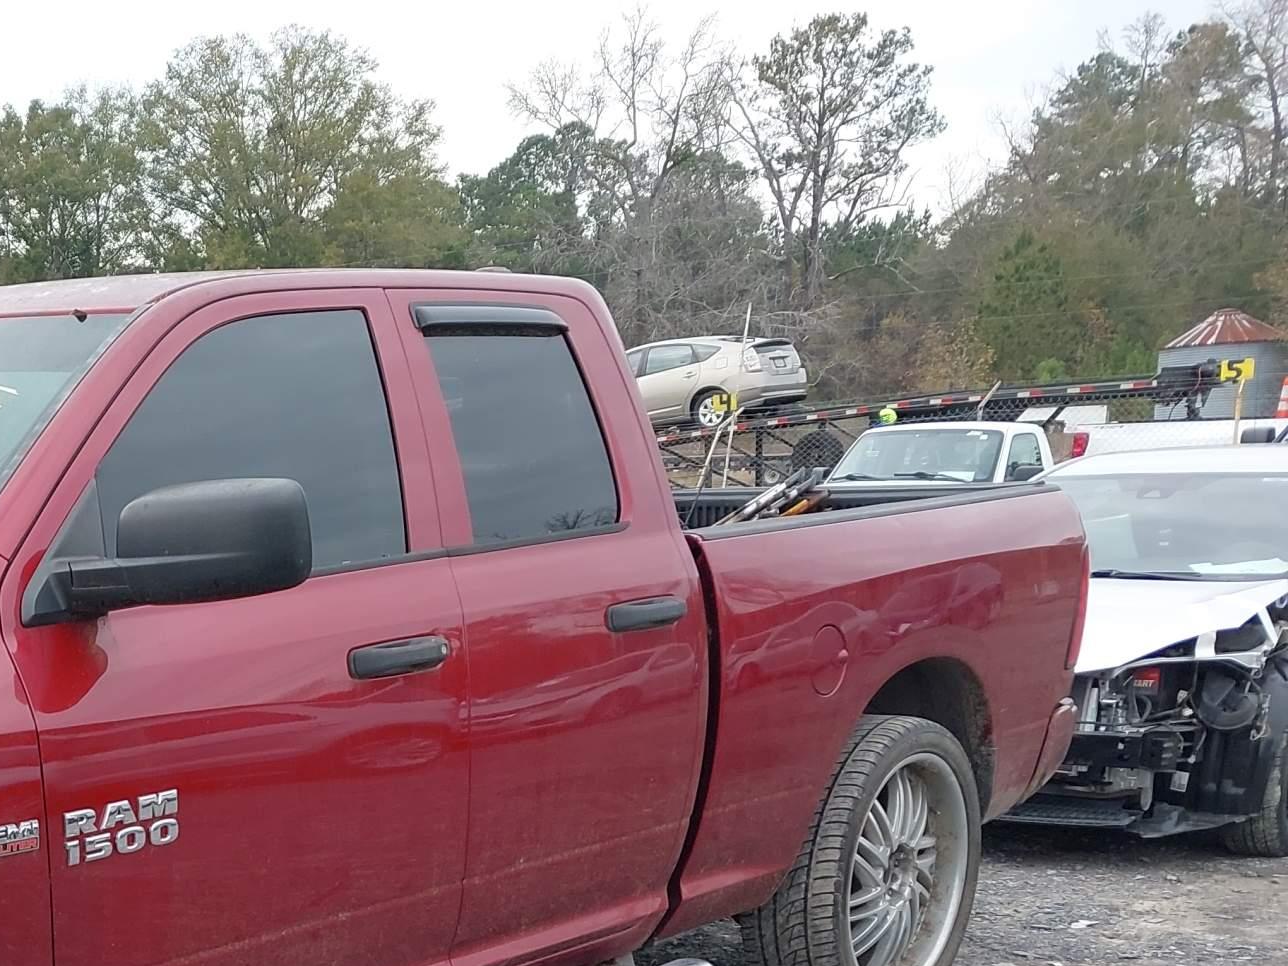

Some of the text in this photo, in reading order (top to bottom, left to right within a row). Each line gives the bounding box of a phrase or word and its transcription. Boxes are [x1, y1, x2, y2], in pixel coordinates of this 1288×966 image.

[1225, 359, 1243, 381] 5
[719, 393, 731, 412] 4
[64, 789, 178, 837] RAM
[65, 818, 179, 866] 1500
